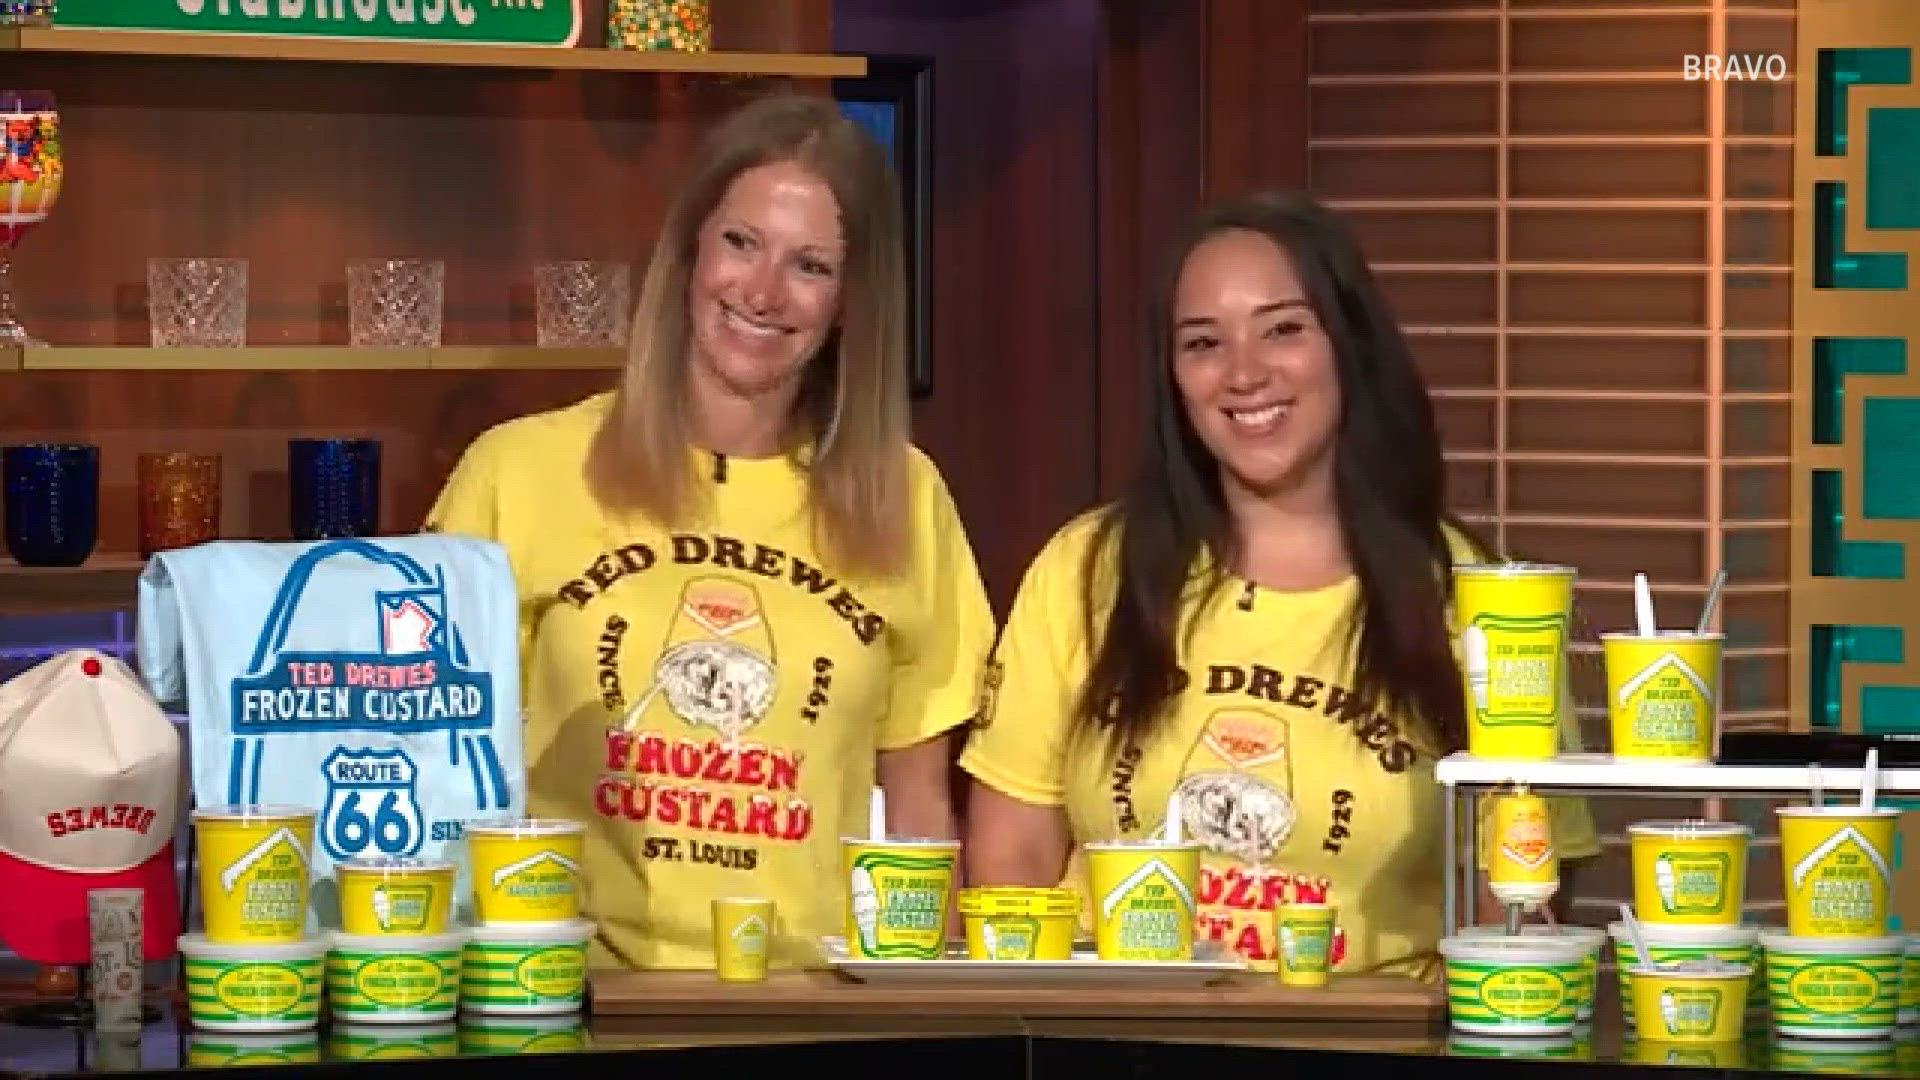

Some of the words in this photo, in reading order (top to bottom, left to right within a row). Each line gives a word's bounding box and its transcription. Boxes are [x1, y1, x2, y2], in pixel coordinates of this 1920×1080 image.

[177, 0, 477, 26] uouse
[557, 543, 656, 610] TED
[671, 535, 885, 645] DREWES
[287, 661, 335, 685] TED
[344, 659, 437, 688] DREWES
[597, 614, 629, 711] SINCE
[800, 656, 834, 723] 1929
[242, 686, 350, 722] FROZEN
[362, 684, 484, 721] CUSTARD
[1205, 663, 1417, 774] DREWES
[336, 761, 402, 782] ROUTE
[605, 728, 804, 790] FROZEN
[335, 790, 410, 852] 66
[593, 779, 813, 842] CUSTARD
[1323, 788, 1355, 855] 1929
[689, 839, 758, 870] LOUIS
[1199, 867, 1332, 910] OZEN
